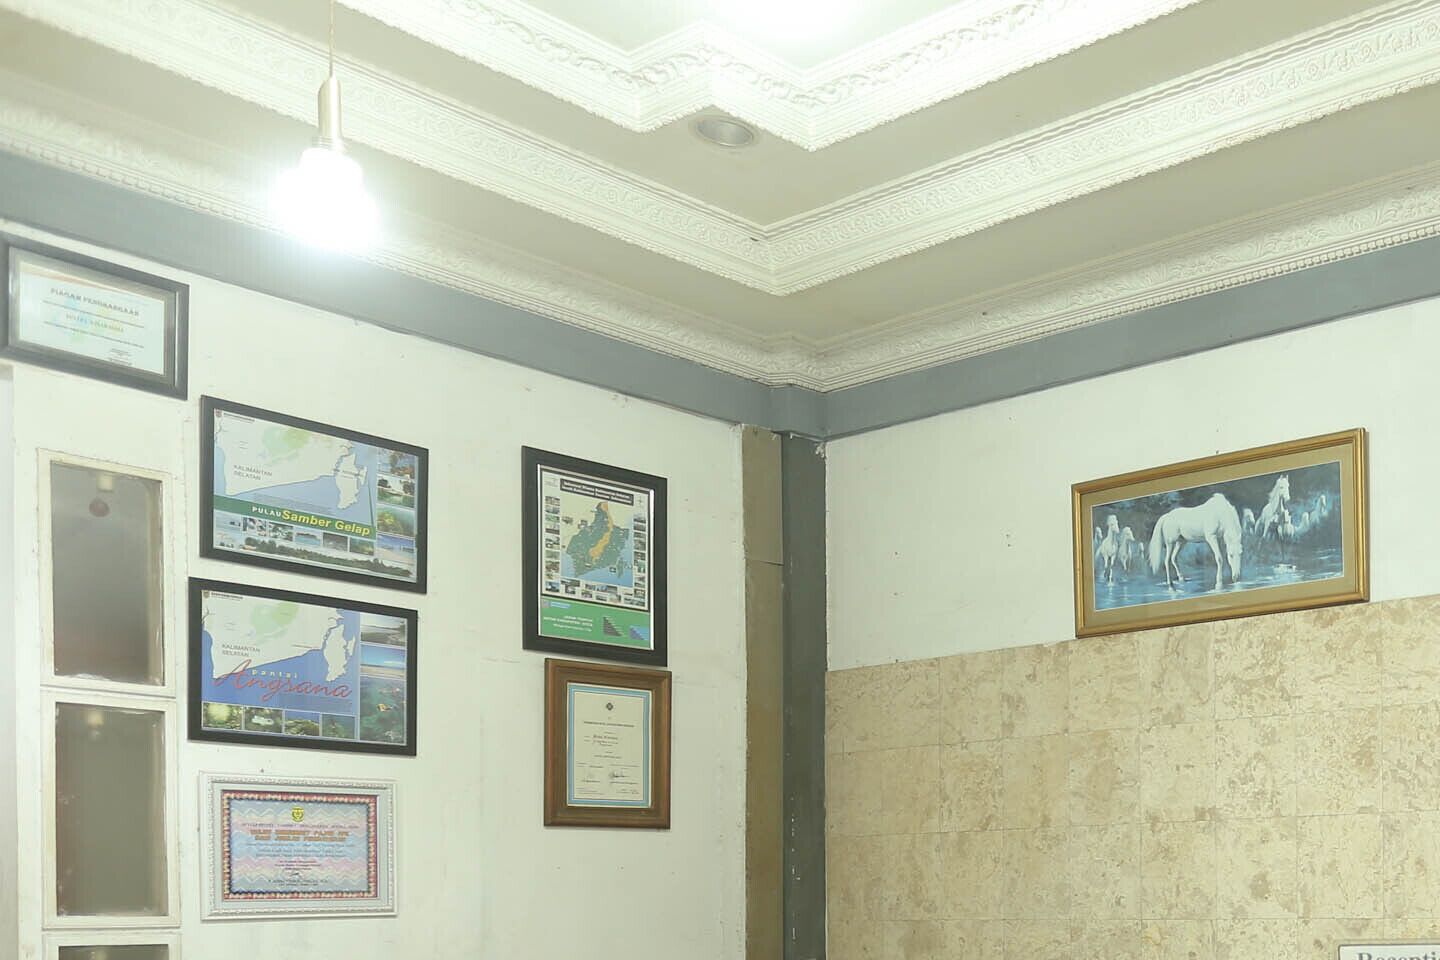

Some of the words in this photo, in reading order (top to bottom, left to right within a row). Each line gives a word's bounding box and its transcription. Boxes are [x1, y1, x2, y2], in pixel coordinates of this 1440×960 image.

[251, 505, 282, 517] PULAU
[281, 509, 332, 528] Samber
[334, 520, 370, 537] Gelap
[211, 659, 352, 702] Angsana
